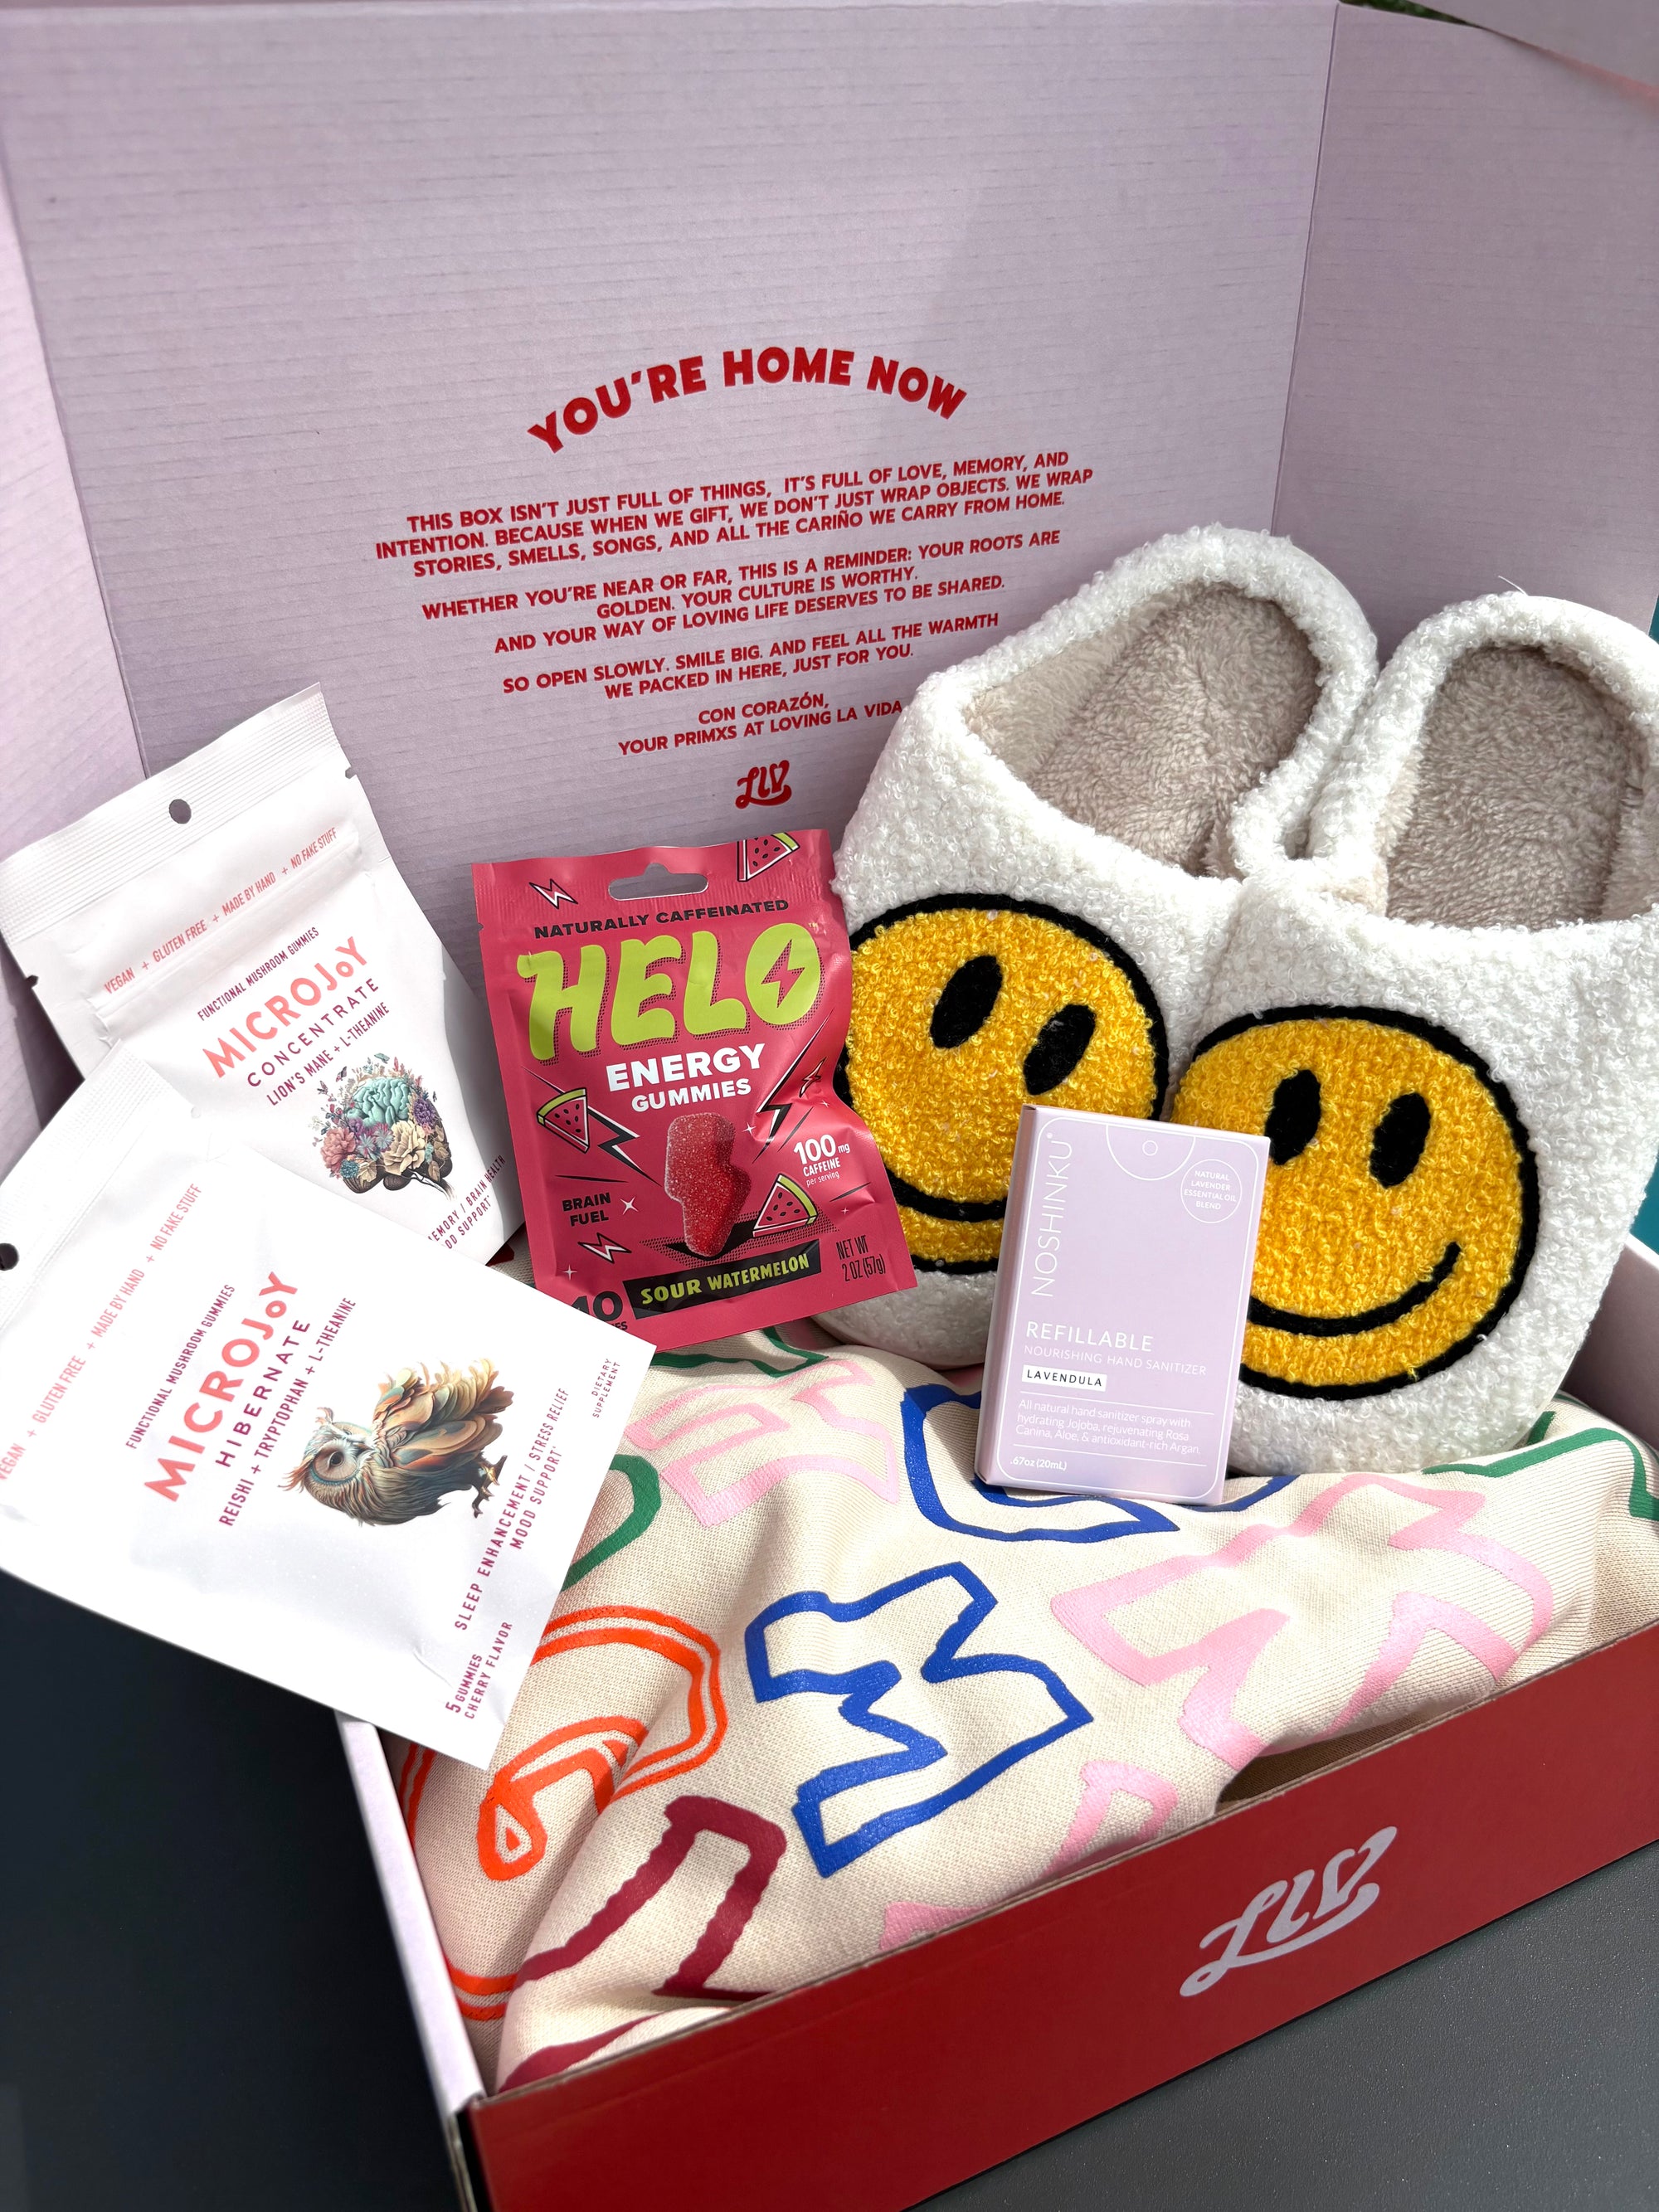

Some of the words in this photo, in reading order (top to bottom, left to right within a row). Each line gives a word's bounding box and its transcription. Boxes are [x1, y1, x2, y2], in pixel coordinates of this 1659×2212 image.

[528, 355, 707, 454] YOU'RE
[722, 347, 854, 387] HOME
[867, 356, 967, 421] NOW
[406, 513, 452, 532] THIS
[460, 508, 503, 527] BOX
[510, 502, 559, 521] ISN'T
[567, 496, 610, 516] JUST
[617, 491, 662, 510] FULL
[669, 488, 693, 504] OF
[700, 480, 771, 501] THINGS,
[785, 475, 815, 493] IT'S
[821, 471, 862, 489] FULL
[868, 468, 892, 484] OF
[898, 463, 946, 481] LOVE,
[953, 455, 1026, 475] MEMORY,
[1034, 452, 1068, 468] AND
[376, 532, 489, 559] INTENTION.
[495, 522, 583, 545] BECAUSE
[591, 515, 647, 534] WHEN
[654, 510, 683, 527] WE
[690, 506, 732, 523] GIFT,
[740, 502, 766, 518] WE
[775, 495, 828, 514] DON'T
[836, 491, 873, 508] JUST
[881, 485, 930, 503] WRAP
[937, 478, 1010, 497] OBJECTS.
[1016, 474, 1039, 489] WE
[1047, 469, 1092, 486] WRAP
[413, 553, 501, 577] STORIES,
[508, 543, 586, 566] SMELLS,
[593, 535, 662, 557] SONGS,
[669, 529, 708, 548] AND
[717, 525, 749, 542] ALL
[756, 521, 789, 537] THE
[795, 510, 863, 533] CARIÑO
[869, 509, 895, 525] WE
[902, 503, 957, 522] CARRY
[964, 497, 1010, 515] FROM
[1015, 491, 1068, 509] HOME.
[421, 594, 518, 620] WHETHER
[525, 584, 596, 606] YOU'RE
[603, 577, 653, 597] NEAR
[660, 574, 686, 591] OR
[693, 569, 732, 586] FAR,
[738, 562, 776, 581] THIS
[783, 560, 798, 575] IS
[805, 558, 817, 572] A
[824, 547, 911, 571] REMINDER:
[918, 542, 964, 559] YOUR
[970, 534, 1022, 553] ROOTS
[1029, 531, 1060, 546] ARE
[597, 596, 676, 619] GOLDEN.
[682, 589, 731, 608] YOUR
[739, 579, 813, 600] CULTURE
[821, 576, 834, 590] IS
[843, 567, 919, 587] WORTHY.
[619, 737, 668, 756] YOUR
[674, 726, 737, 747] PRIMXS
[744, 722, 764, 737] AT
[771, 711, 831, 732] LOVING
[837, 707, 857, 722] LA
[864, 701, 902, 717] VIDA
[698, 707, 735, 724] CON
[742, 692, 828, 718] CORAZÓN,
[103, 968, 134, 994] VEGAN
[152, 934, 186, 963] GLUTEN
[185, 920, 207, 941] FREE
[221, 892, 245, 916] MADE
[242, 886, 254, 902] BY
[255, 872, 276, 893] HAND
[289, 853, 302, 869] NO
[300, 842, 319, 860] FAKE
[317, 827, 336, 848] STUFF
[534, 914, 648, 938] NATURALLY
[655, 900, 788, 923] CAFFEINATED
[197, 983, 247, 1020] FUNCTIONAL
[245, 950, 289, 987] MUSHROOM
[285, 926, 320, 956] GUMMIES
[517, 922, 822, 1062] HELO
[247, 979, 379, 1087] CONCENTRATE
[265, 1071, 307, 1107] LION'S
[303, 1049, 334, 1077] MANE
[340, 1001, 391, 1048] L-THEANINE
[606, 1043, 765, 1091] ENERGY
[631, 1081, 752, 1112] GUMMIES
[793, 1135, 836, 1164] 100
[838, 1143, 850, 1155] mg
[803, 1157, 840, 1177] CAFFEINE
[806, 1178, 817, 1188] per
[818, 1170, 839, 1184] serving
[1184, 1189, 1224, 1200] ESSENTIAL
[1191, 1180, 1230, 1191] LAVENDER
[1194, 1170, 1229, 1181] NATURAL
[562, 1193, 611, 1212] BRAIN
[570, 1210, 609, 1227] FUEL
[1031, 1140, 1072, 1297] NOSHINKU
[1195, 1200, 1221, 1210] BLEND
[836, 1237, 854, 1261] NET
[854, 1235, 868, 1255] WT
[842, 1263, 849, 1281] 2
[850, 1259, 863, 1281] OZ
[863, 1254, 886, 1280] (57g)
[640, 1278, 704, 1305] SOUR
[706, 1253, 809, 1291] WATERMELON
[1026, 1321, 1154, 1352] REFILLABLE
[124, 1388, 173, 1450] FUNCTIONAL
[166, 1329, 207, 1384] MUSHROOM
[201, 1285, 235, 1327] GUMMIES
[591, 1359, 611, 1397] DIETARY
[1024, 1344, 1102, 1365] NOURISHING
[1107, 1354, 1142, 1369] HAND
[1146, 1359, 1206, 1376] SANITIZER
[1026, 1369, 1102, 1387] LAVENDULA
[216, 1320, 310, 1467] HIBERNATE
[592, 1361, 620, 1417] SUPPLEMENT
[218, 1478, 255, 1526] REISHI
[254, 1378, 309, 1458] TRYPTOPHAN
[308, 1297, 356, 1362] L-THEANINE
[1017, 1412, 1064, 1428] hydrating
[1067, 1420, 1101, 1432] Jojoba,
[1102, 1423, 1164, 1440] rejuvenating
[1165, 1429, 1189, 1441] Rosa
[1019, 1399, 1033, 1409] All
[1034, 1402, 1069, 1414] natural
[1071, 1407, 1096, 1417] hand
[1097, 1409, 1140, 1422] sanitizer
[1141, 1415, 1168, 1427] spray
[1168, 1417, 1191, 1427] with
[1016, 1425, 1053, 1439] Canina,
[1054, 1429, 1078, 1441] Aloe,
[1081, 1432, 1089, 1442] &
[1091, 1434, 1168, 1451] antioxidant-rich
[1170, 1442, 1201, 1454] Argan.
[1010, 1456, 1034, 1467] .67oz
[1036, 1458, 1067, 1471] (20mL)
[454, 1583, 483, 1631] SLEEP
[477, 1474, 530, 1578] ENHANCEMENT
[528, 1422, 554, 1461] STRESS
[546, 1388, 569, 1422] RELIEF
[509, 1510, 536, 1551] MOOD
[445, 1701, 461, 1713] 5
[455, 1654, 483, 1702] GUMMIES
[464, 1672, 491, 1719] CHERRY
[485, 1621, 513, 1668] FLAVOR
